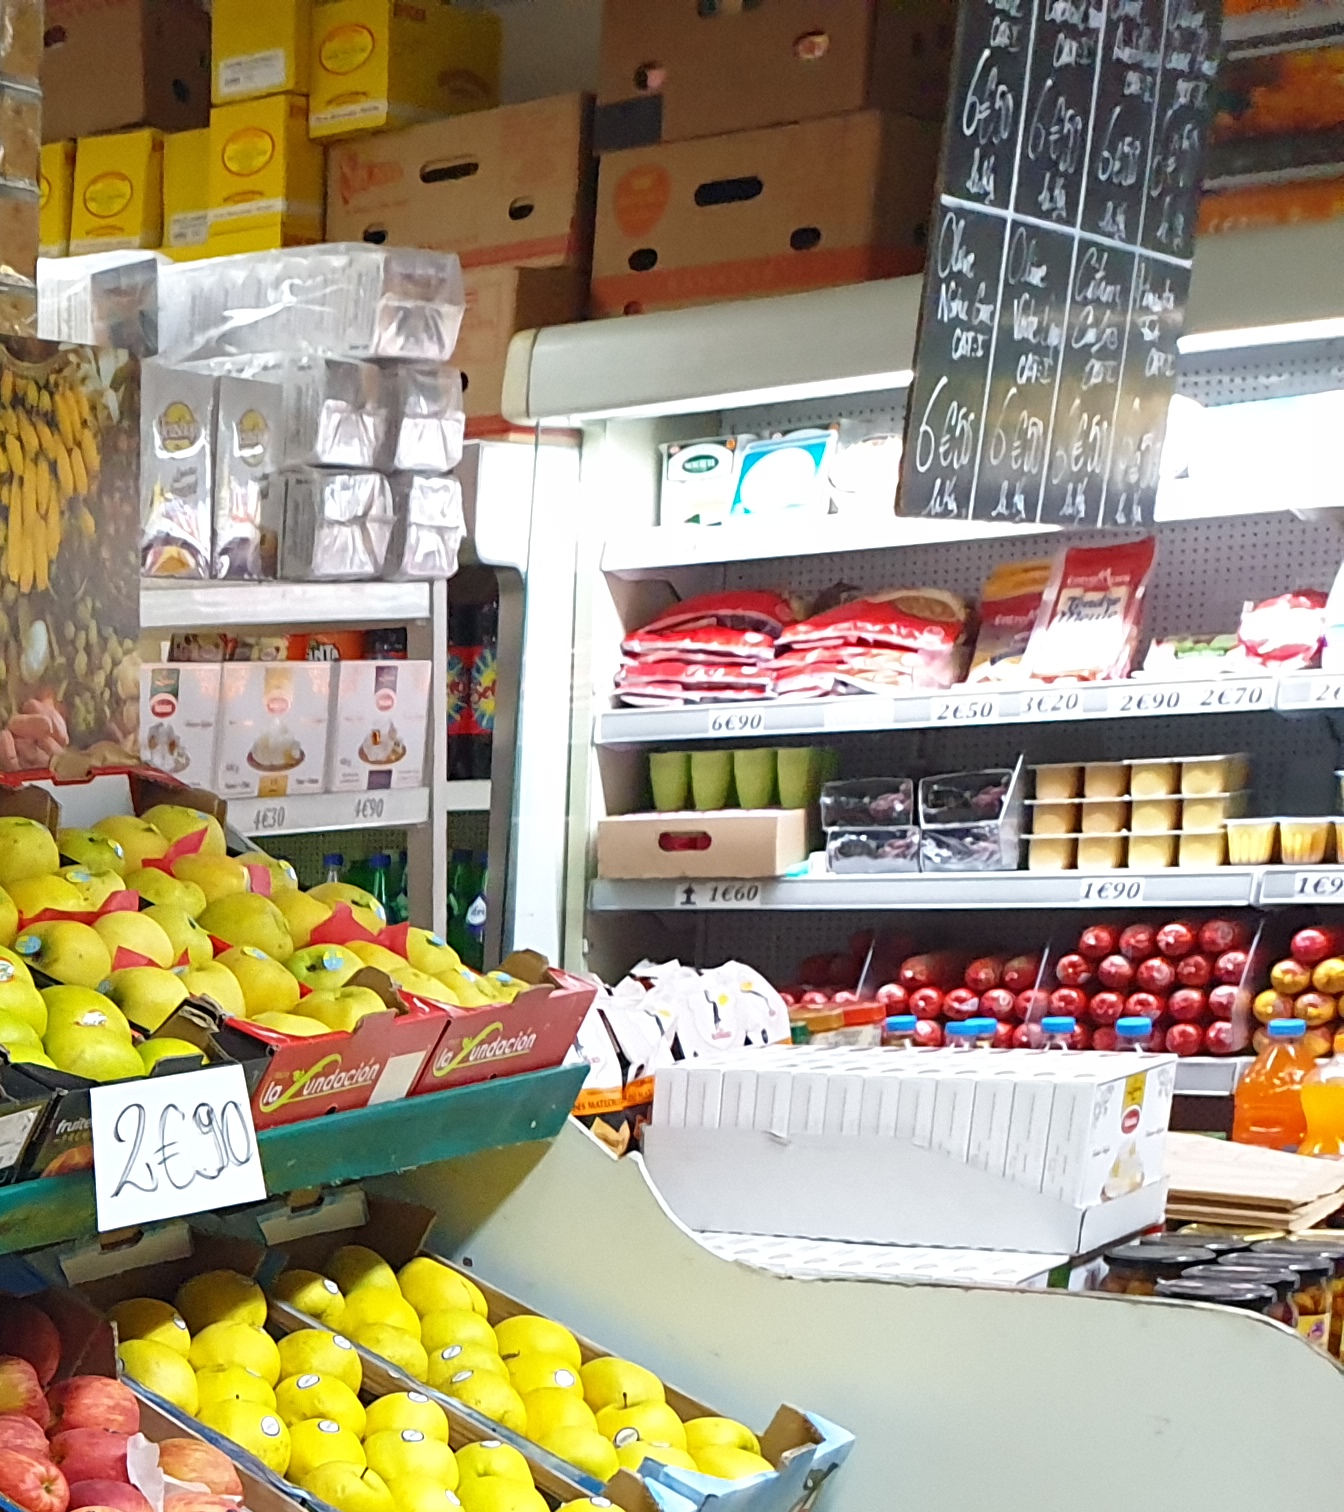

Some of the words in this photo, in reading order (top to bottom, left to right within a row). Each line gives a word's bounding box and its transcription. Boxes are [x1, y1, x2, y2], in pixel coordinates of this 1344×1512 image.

[1021, 693, 1079, 713] 3€20
[1119, 691, 1180, 711] 2€90
[1200, 687, 1263, 706] 2€70
[937, 702, 993, 720] 2€50
[711, 714, 763, 731] 6€90
[709, 885, 759, 902] 1€60
[1084, 881, 1141, 900] 1€90
[55, 1118, 91, 1135] fruite
[110, 1100, 253, 1199] 2€90
